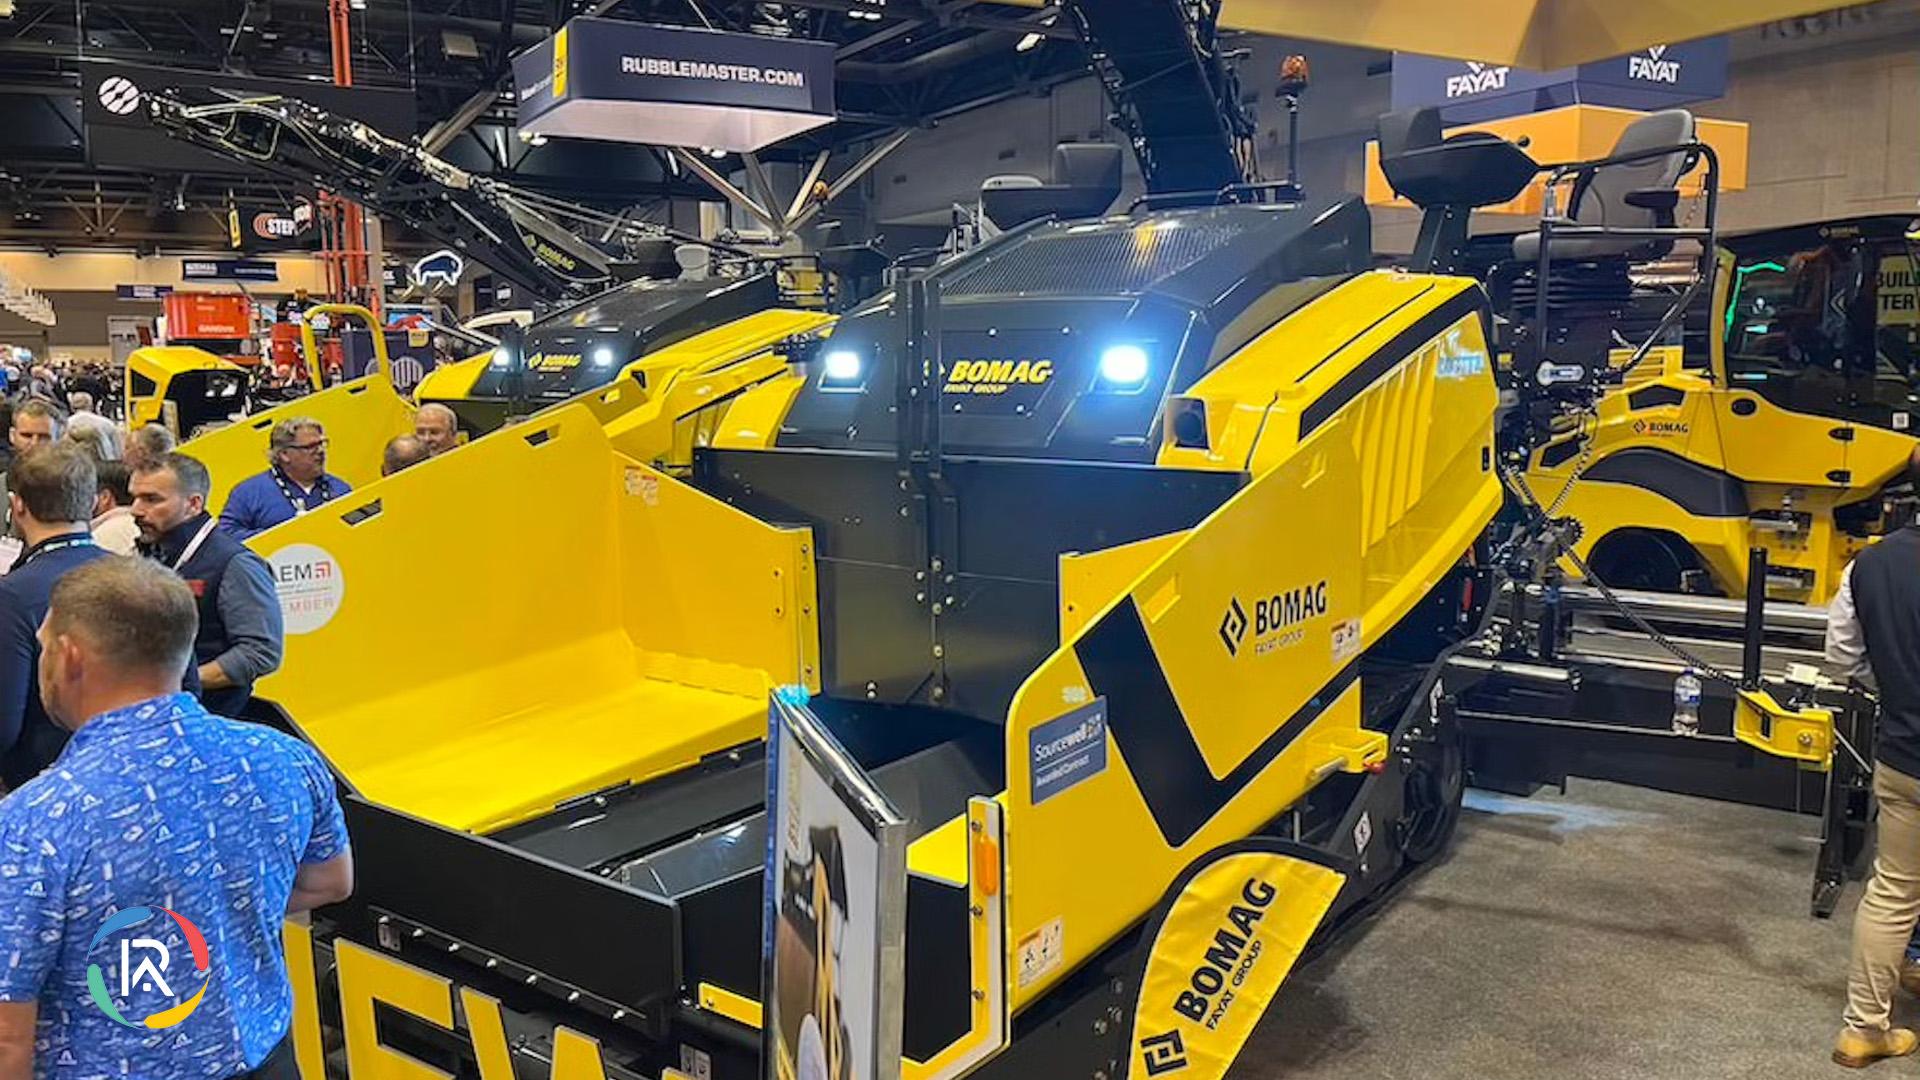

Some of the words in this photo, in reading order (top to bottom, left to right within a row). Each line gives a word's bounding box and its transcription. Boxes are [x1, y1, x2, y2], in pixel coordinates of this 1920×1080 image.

[621, 56, 804, 87] RUBBLEMASTER.COM
[1446, 67, 1510, 98] FAYAT
[1629, 56, 1680, 84] FAYAT
[947, 360, 1052, 383] BOMAG
[1649, 422, 1689, 433] BOMAG
[1255, 580, 1327, 636] BOMAG
[1173, 877, 1276, 1022] BOMAG
[1206, 991, 1235, 1031] FAYAT
[1231, 940, 1262, 987] GROUP
